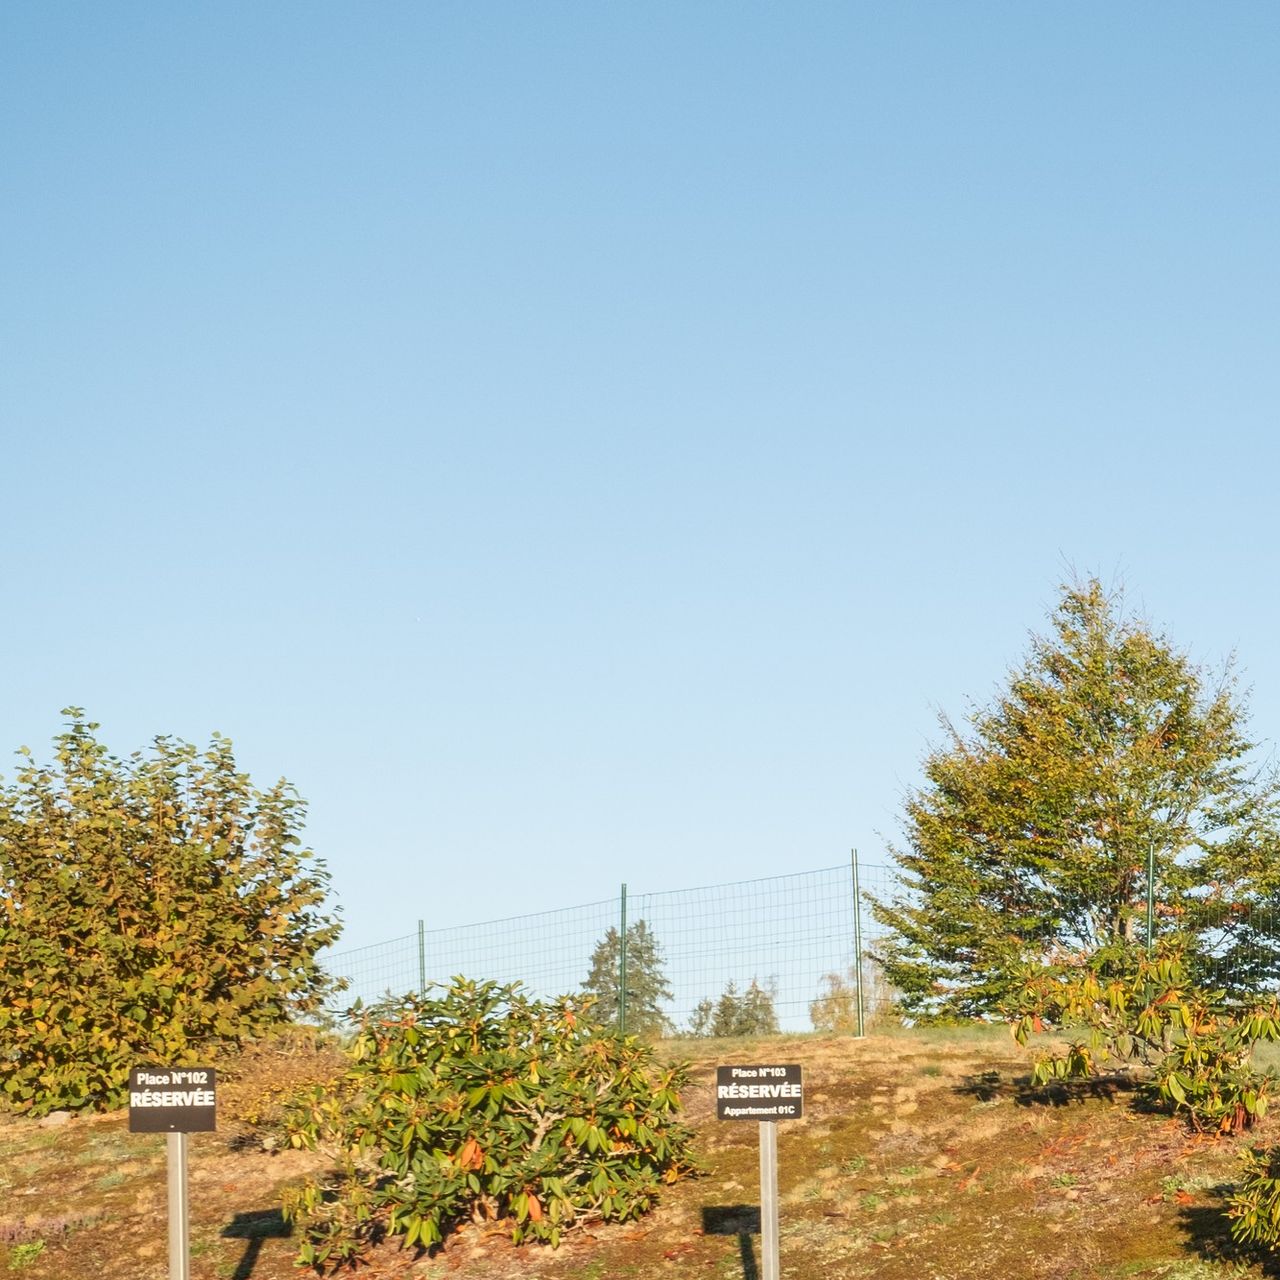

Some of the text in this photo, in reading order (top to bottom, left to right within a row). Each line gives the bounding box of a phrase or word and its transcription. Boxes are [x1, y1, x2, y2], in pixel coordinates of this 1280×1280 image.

[137, 1073, 170, 1085] Place
[732, 1068, 757, 1078] Place
[717, 1081, 802, 1099] RÉSERVÉE
[130, 1087, 215, 1108] RÉSERVÉE
[724, 1106, 778, 1117] Appartement
